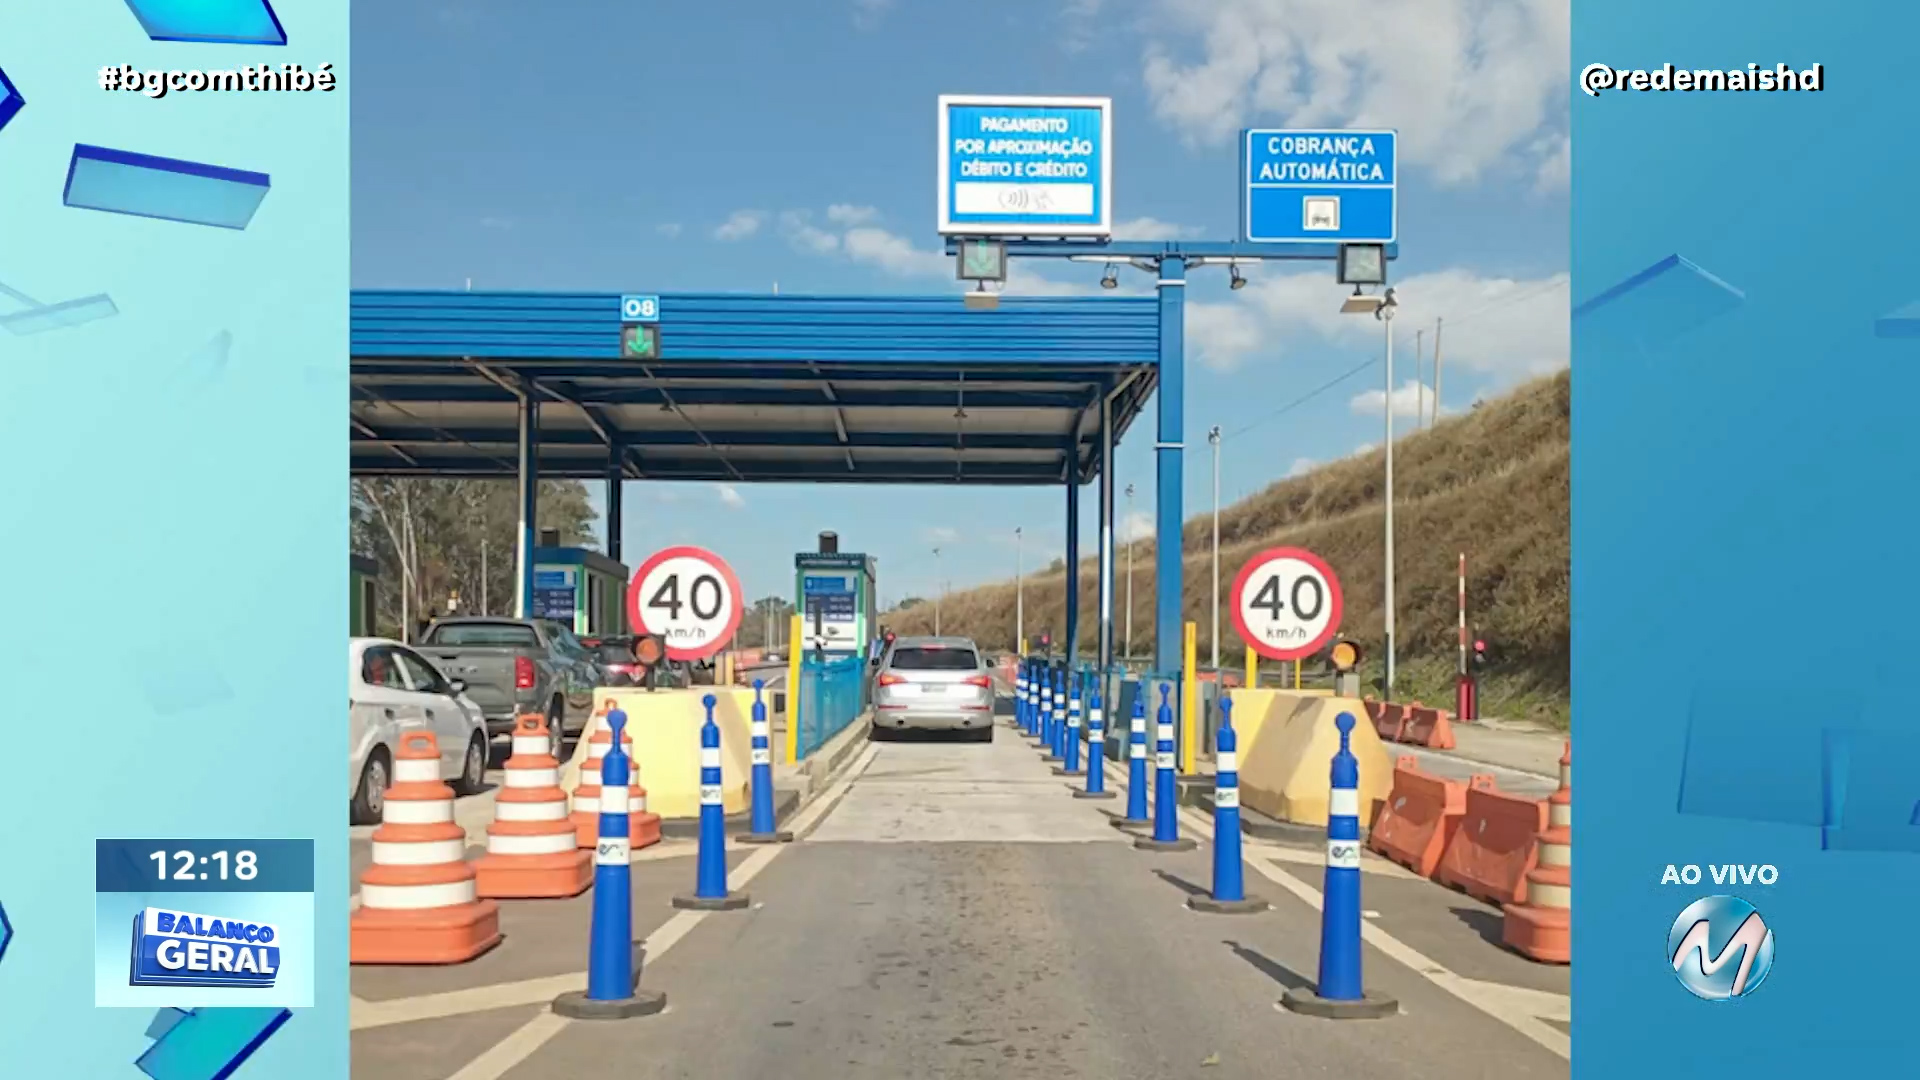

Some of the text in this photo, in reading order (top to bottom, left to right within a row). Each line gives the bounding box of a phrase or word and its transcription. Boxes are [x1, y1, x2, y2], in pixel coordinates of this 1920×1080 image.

[980, 116, 1069, 133] PAGAMENTO
[955, 136, 1093, 158] POR APROXIMAÇÃO
[1267, 136, 1376, 159] COBRANÇA
[961, 158, 1088, 178] DÉBITO E CRÉDITO
[1259, 157, 1385, 181] AUTOMÁTICA
[625, 299, 654, 317] 08
[648, 573, 723, 621] 40
[1249, 573, 1324, 622] 40
[664, 626, 707, 639] km/h
[1266, 626, 1308, 640] km/h
